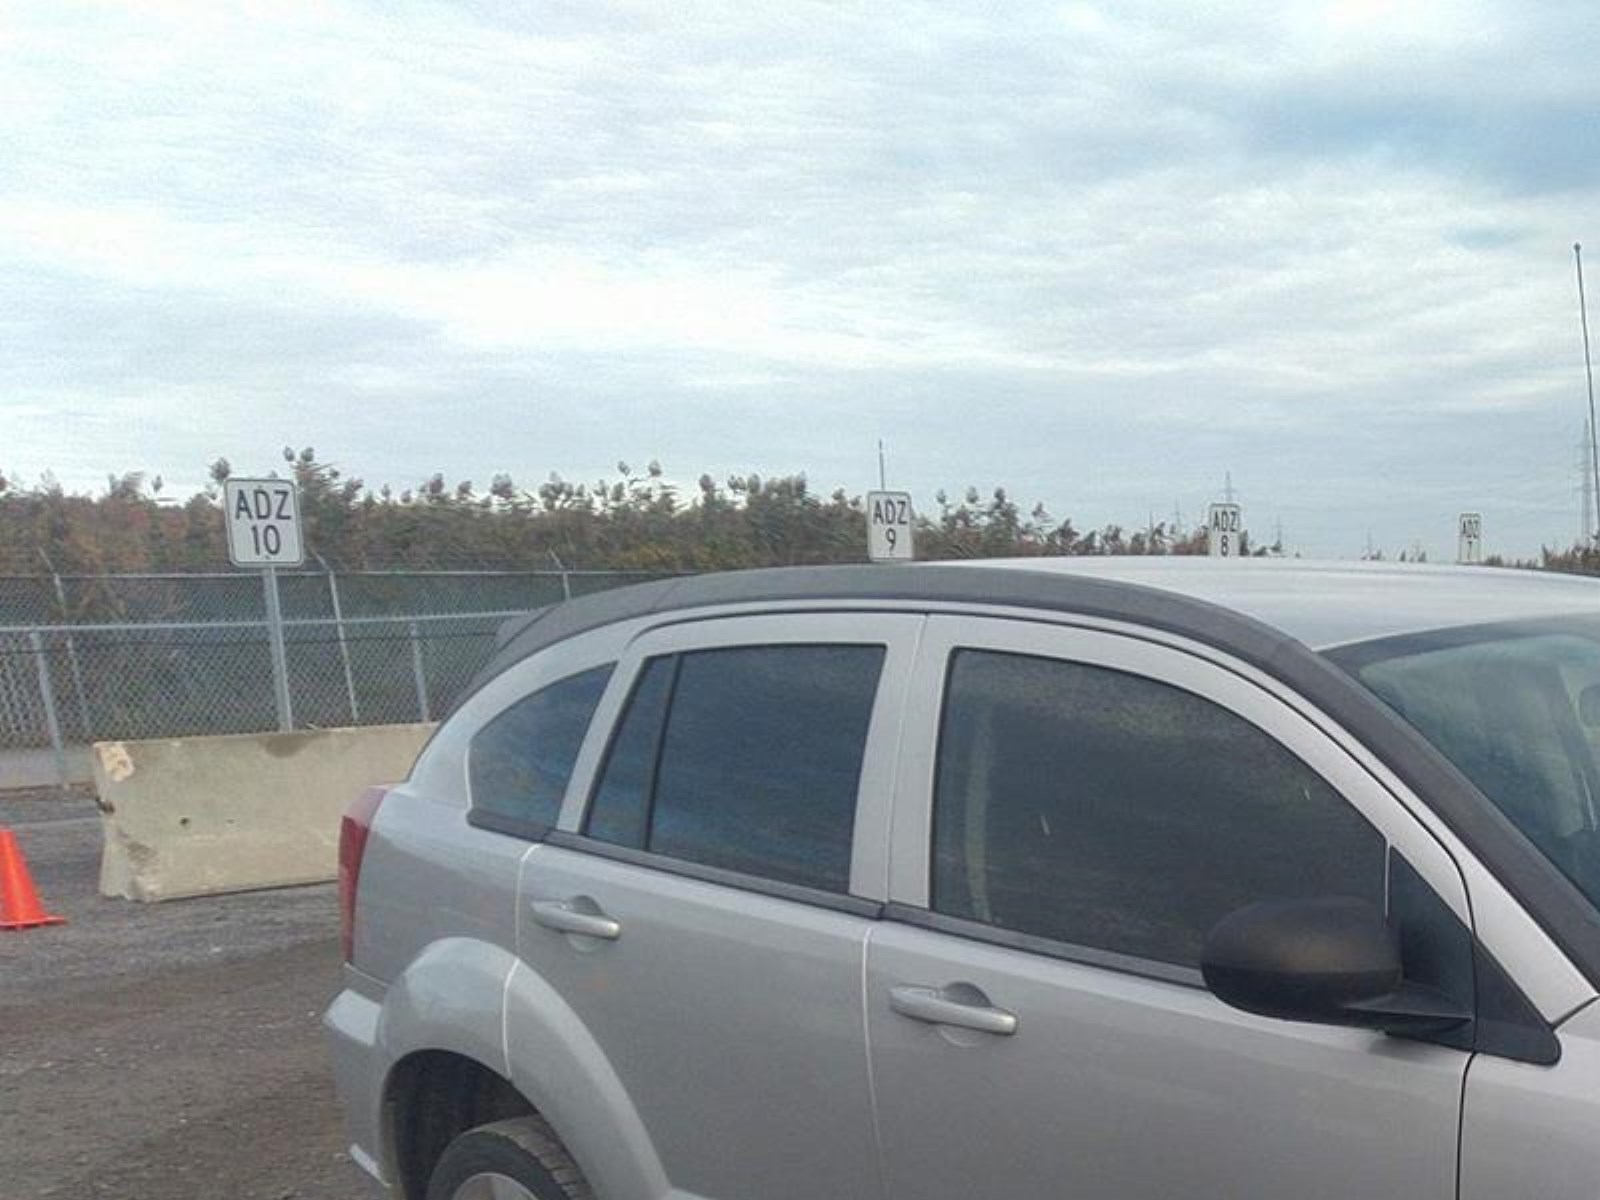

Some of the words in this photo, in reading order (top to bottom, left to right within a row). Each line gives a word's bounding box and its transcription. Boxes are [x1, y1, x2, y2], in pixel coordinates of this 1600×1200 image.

[235, 489, 292, 520] ADZ
[873, 500, 908, 525] ADZ
[1212, 510, 1238, 532] ADZ
[251, 524, 281, 556] 10
[885, 527, 897, 556] 9
[1220, 534, 1229, 557] 8
